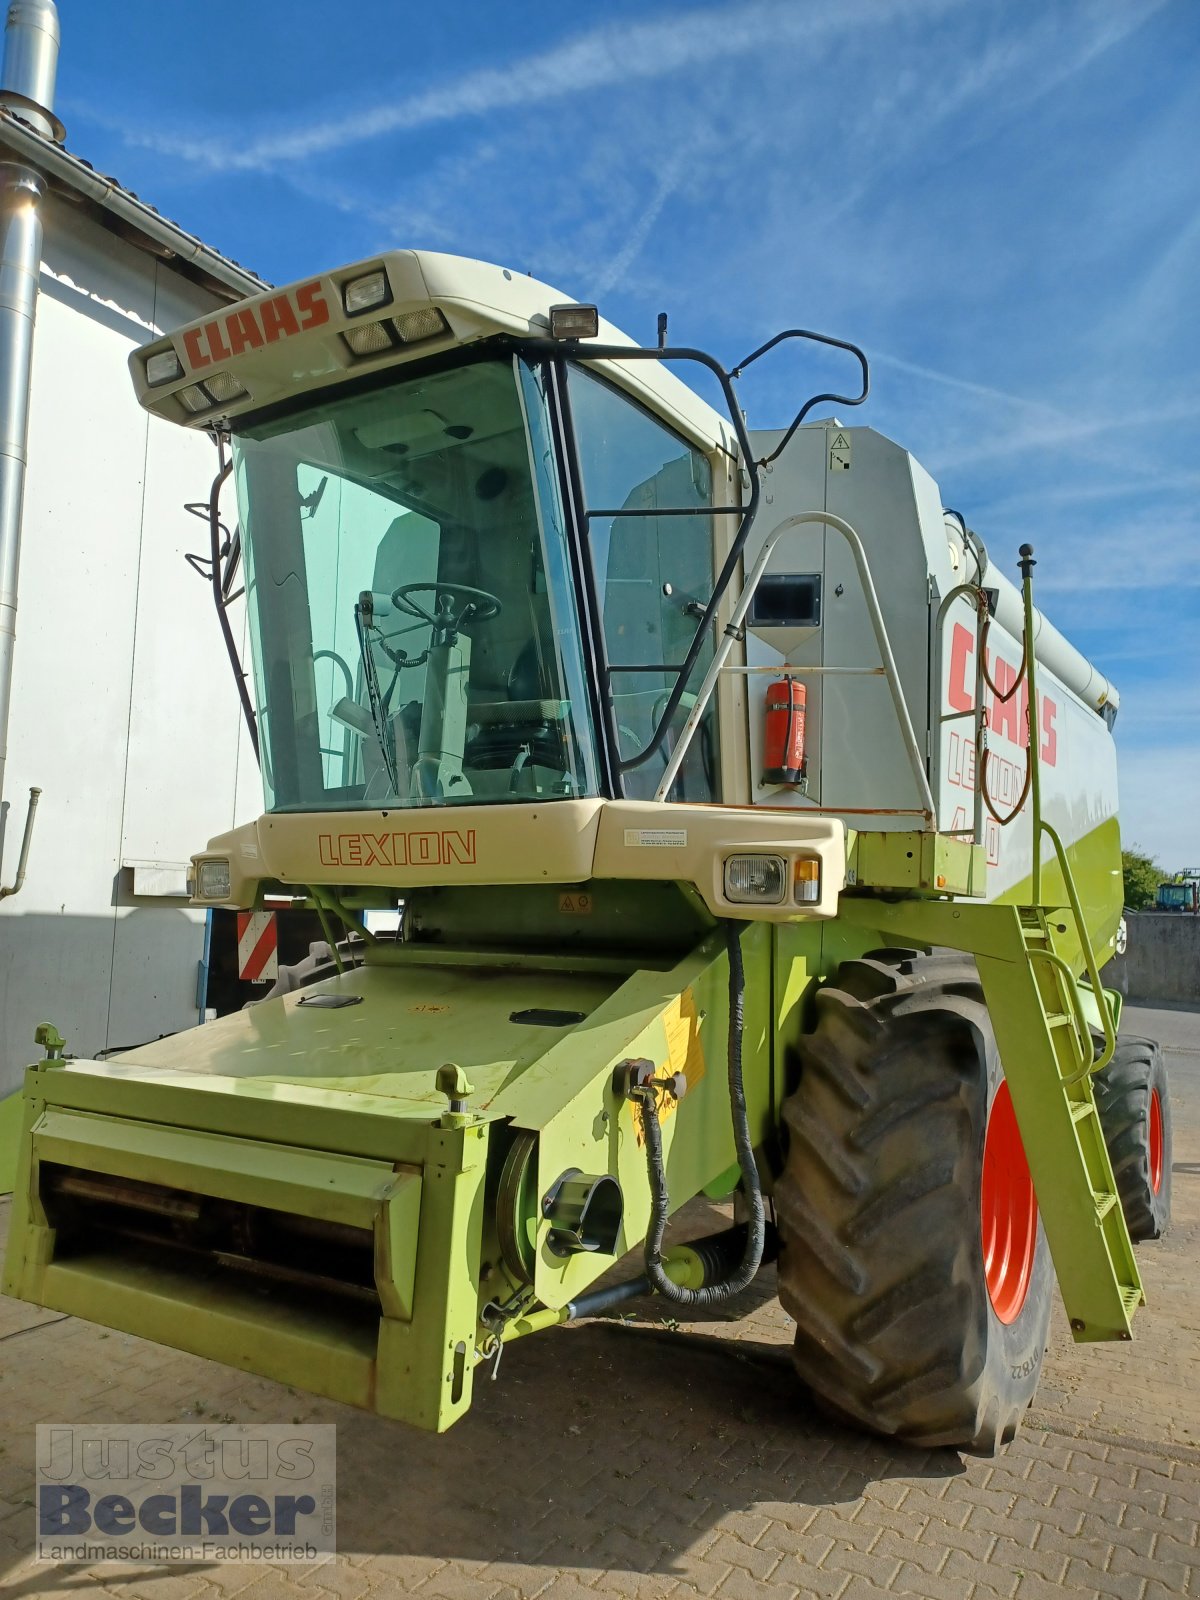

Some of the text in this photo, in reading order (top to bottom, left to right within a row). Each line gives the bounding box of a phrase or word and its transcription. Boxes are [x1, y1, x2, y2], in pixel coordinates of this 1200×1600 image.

[182, 281, 330, 369] CLAAS
[948, 621, 1057, 768] CAAS
[318, 829, 477, 866] LEXION
